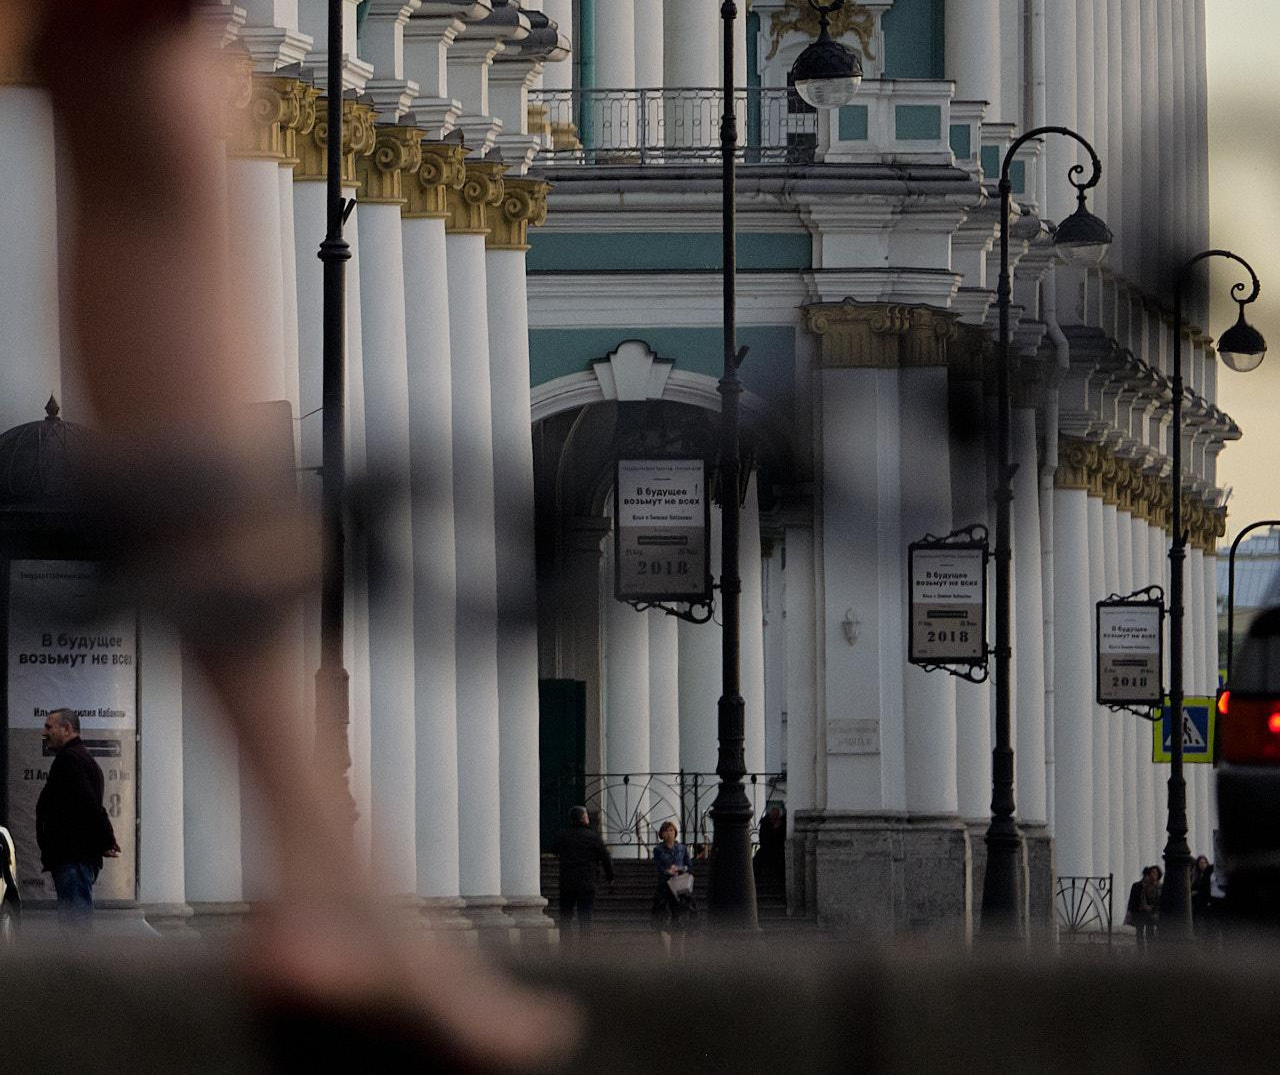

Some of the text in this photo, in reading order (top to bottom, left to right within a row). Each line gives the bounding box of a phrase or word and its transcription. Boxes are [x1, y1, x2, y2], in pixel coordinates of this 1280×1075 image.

[637, 486, 687, 498] В будущее
[624, 498, 661, 506] возьмут
[42, 633, 123, 651] В будущее
[927, 631, 969, 643] 2018
[19, 653, 88, 668] возьмут
[91, 654, 109, 665] не
[24, 769, 33, 780] 21
